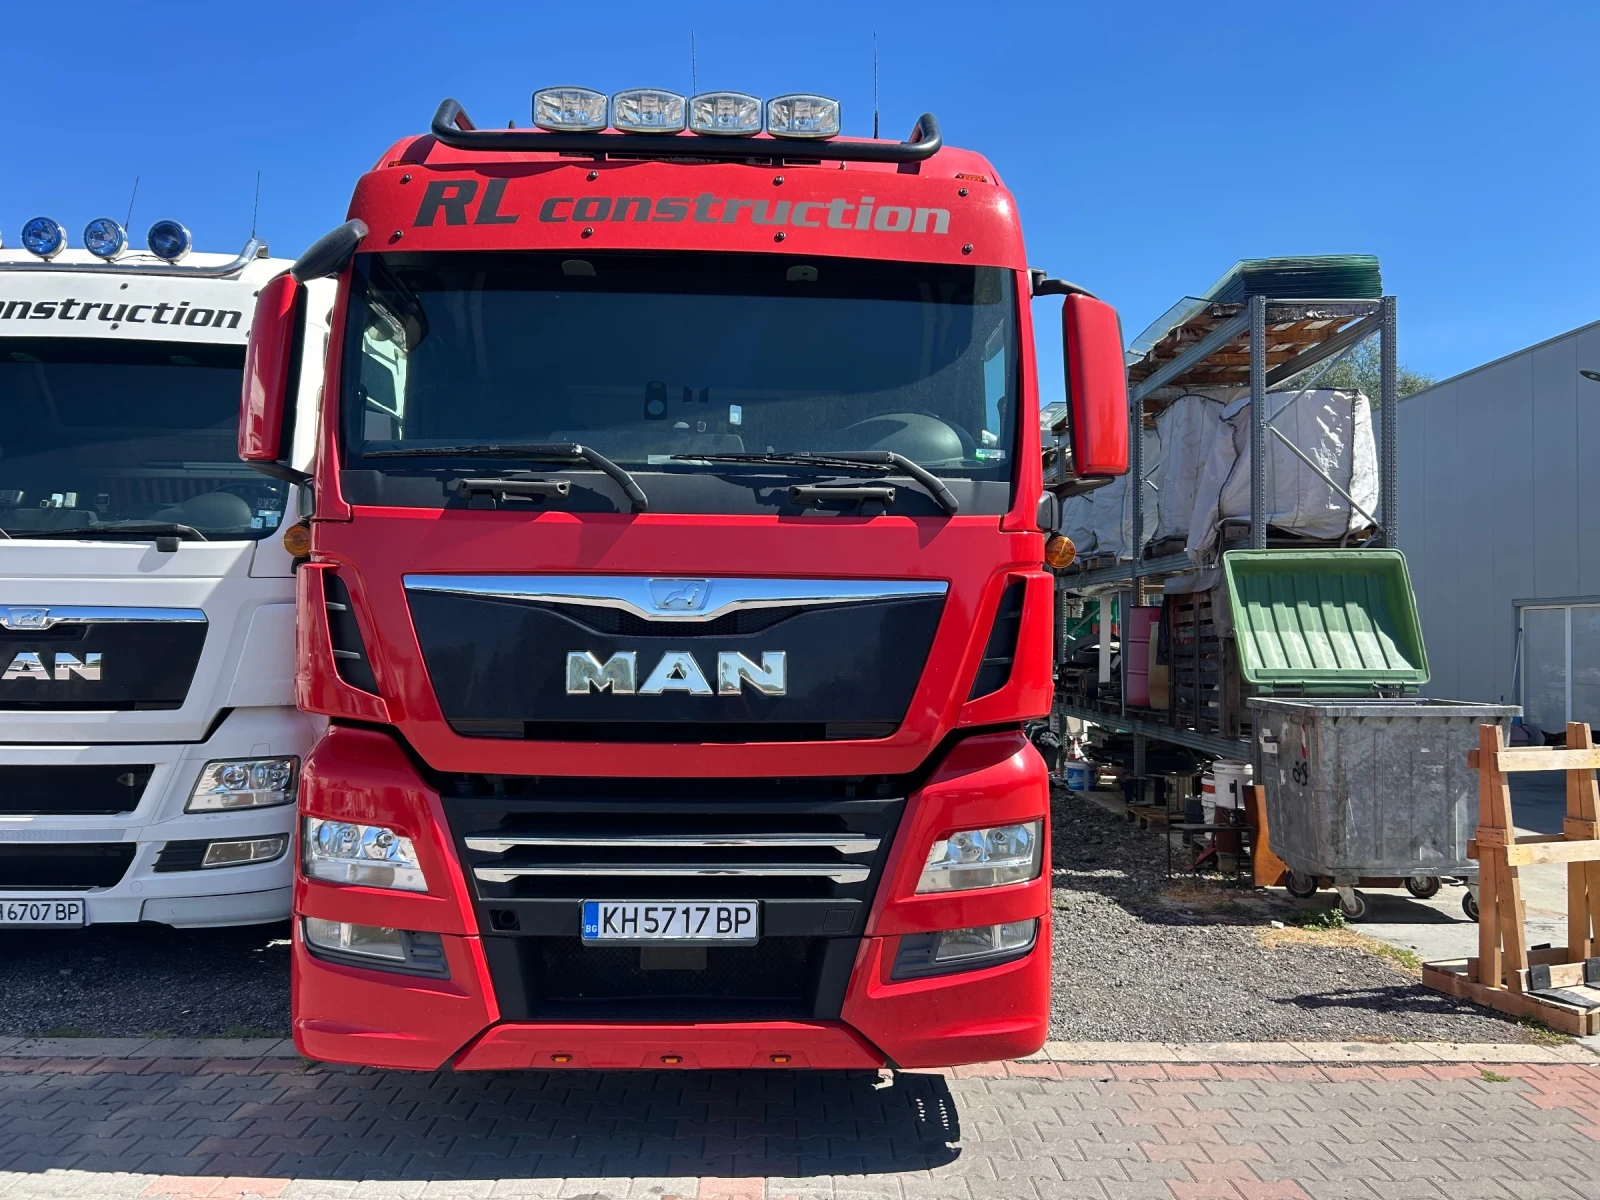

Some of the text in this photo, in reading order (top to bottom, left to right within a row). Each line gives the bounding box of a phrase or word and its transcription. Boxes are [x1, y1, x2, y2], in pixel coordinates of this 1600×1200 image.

[412, 179, 951, 234] RL construction
[0, 298, 243, 328] nstruction
[565, 650, 787, 695] MAN
[585, 924, 598, 933] BG
